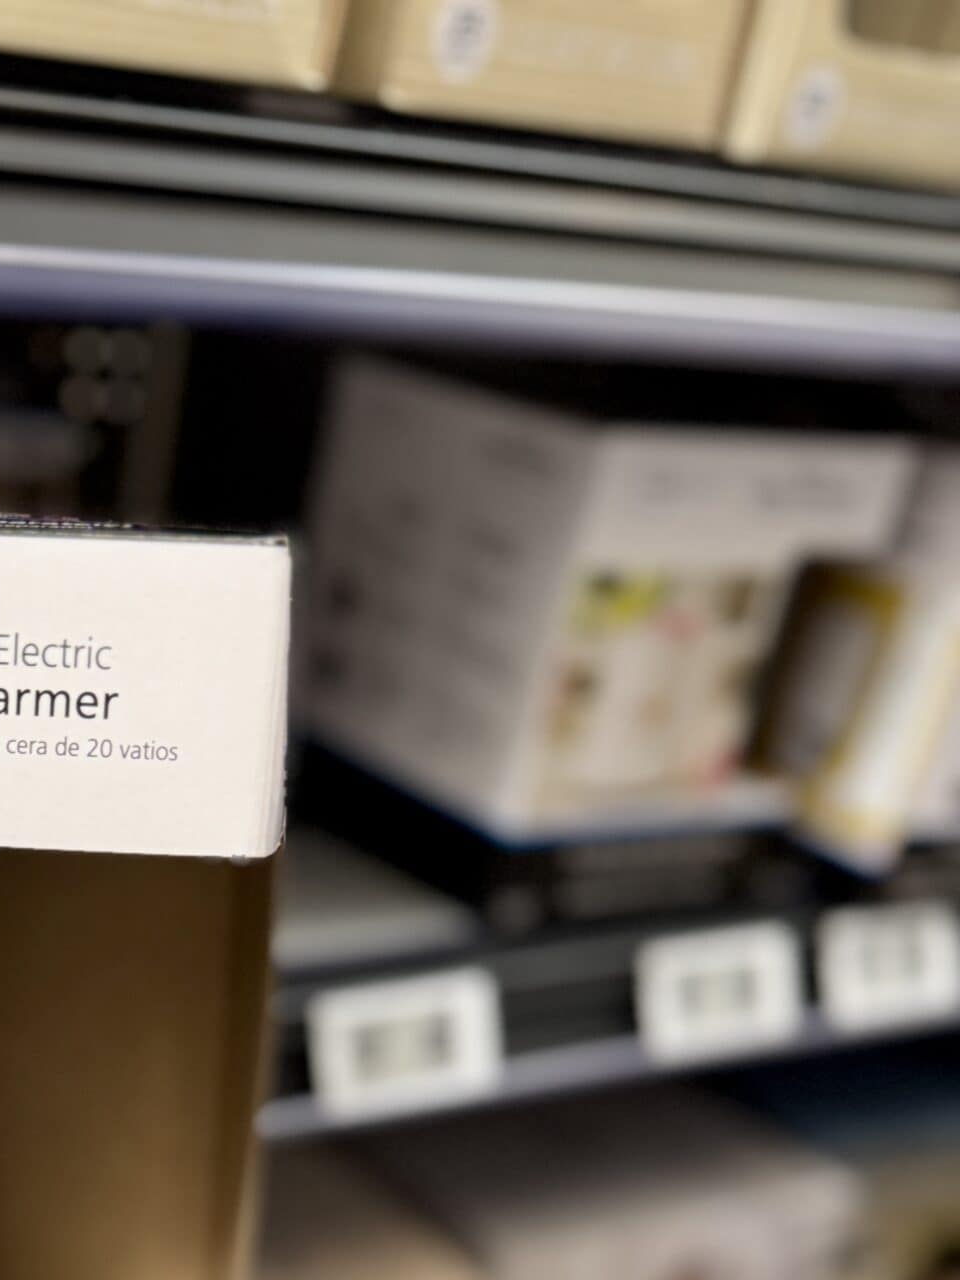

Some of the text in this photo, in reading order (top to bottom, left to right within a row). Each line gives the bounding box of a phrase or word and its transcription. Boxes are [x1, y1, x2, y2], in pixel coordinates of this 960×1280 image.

[6, 738, 47, 756] cera
[55, 736, 80, 757] de
[86, 738, 113, 758] 20
[119, 740, 178, 761] vatios
